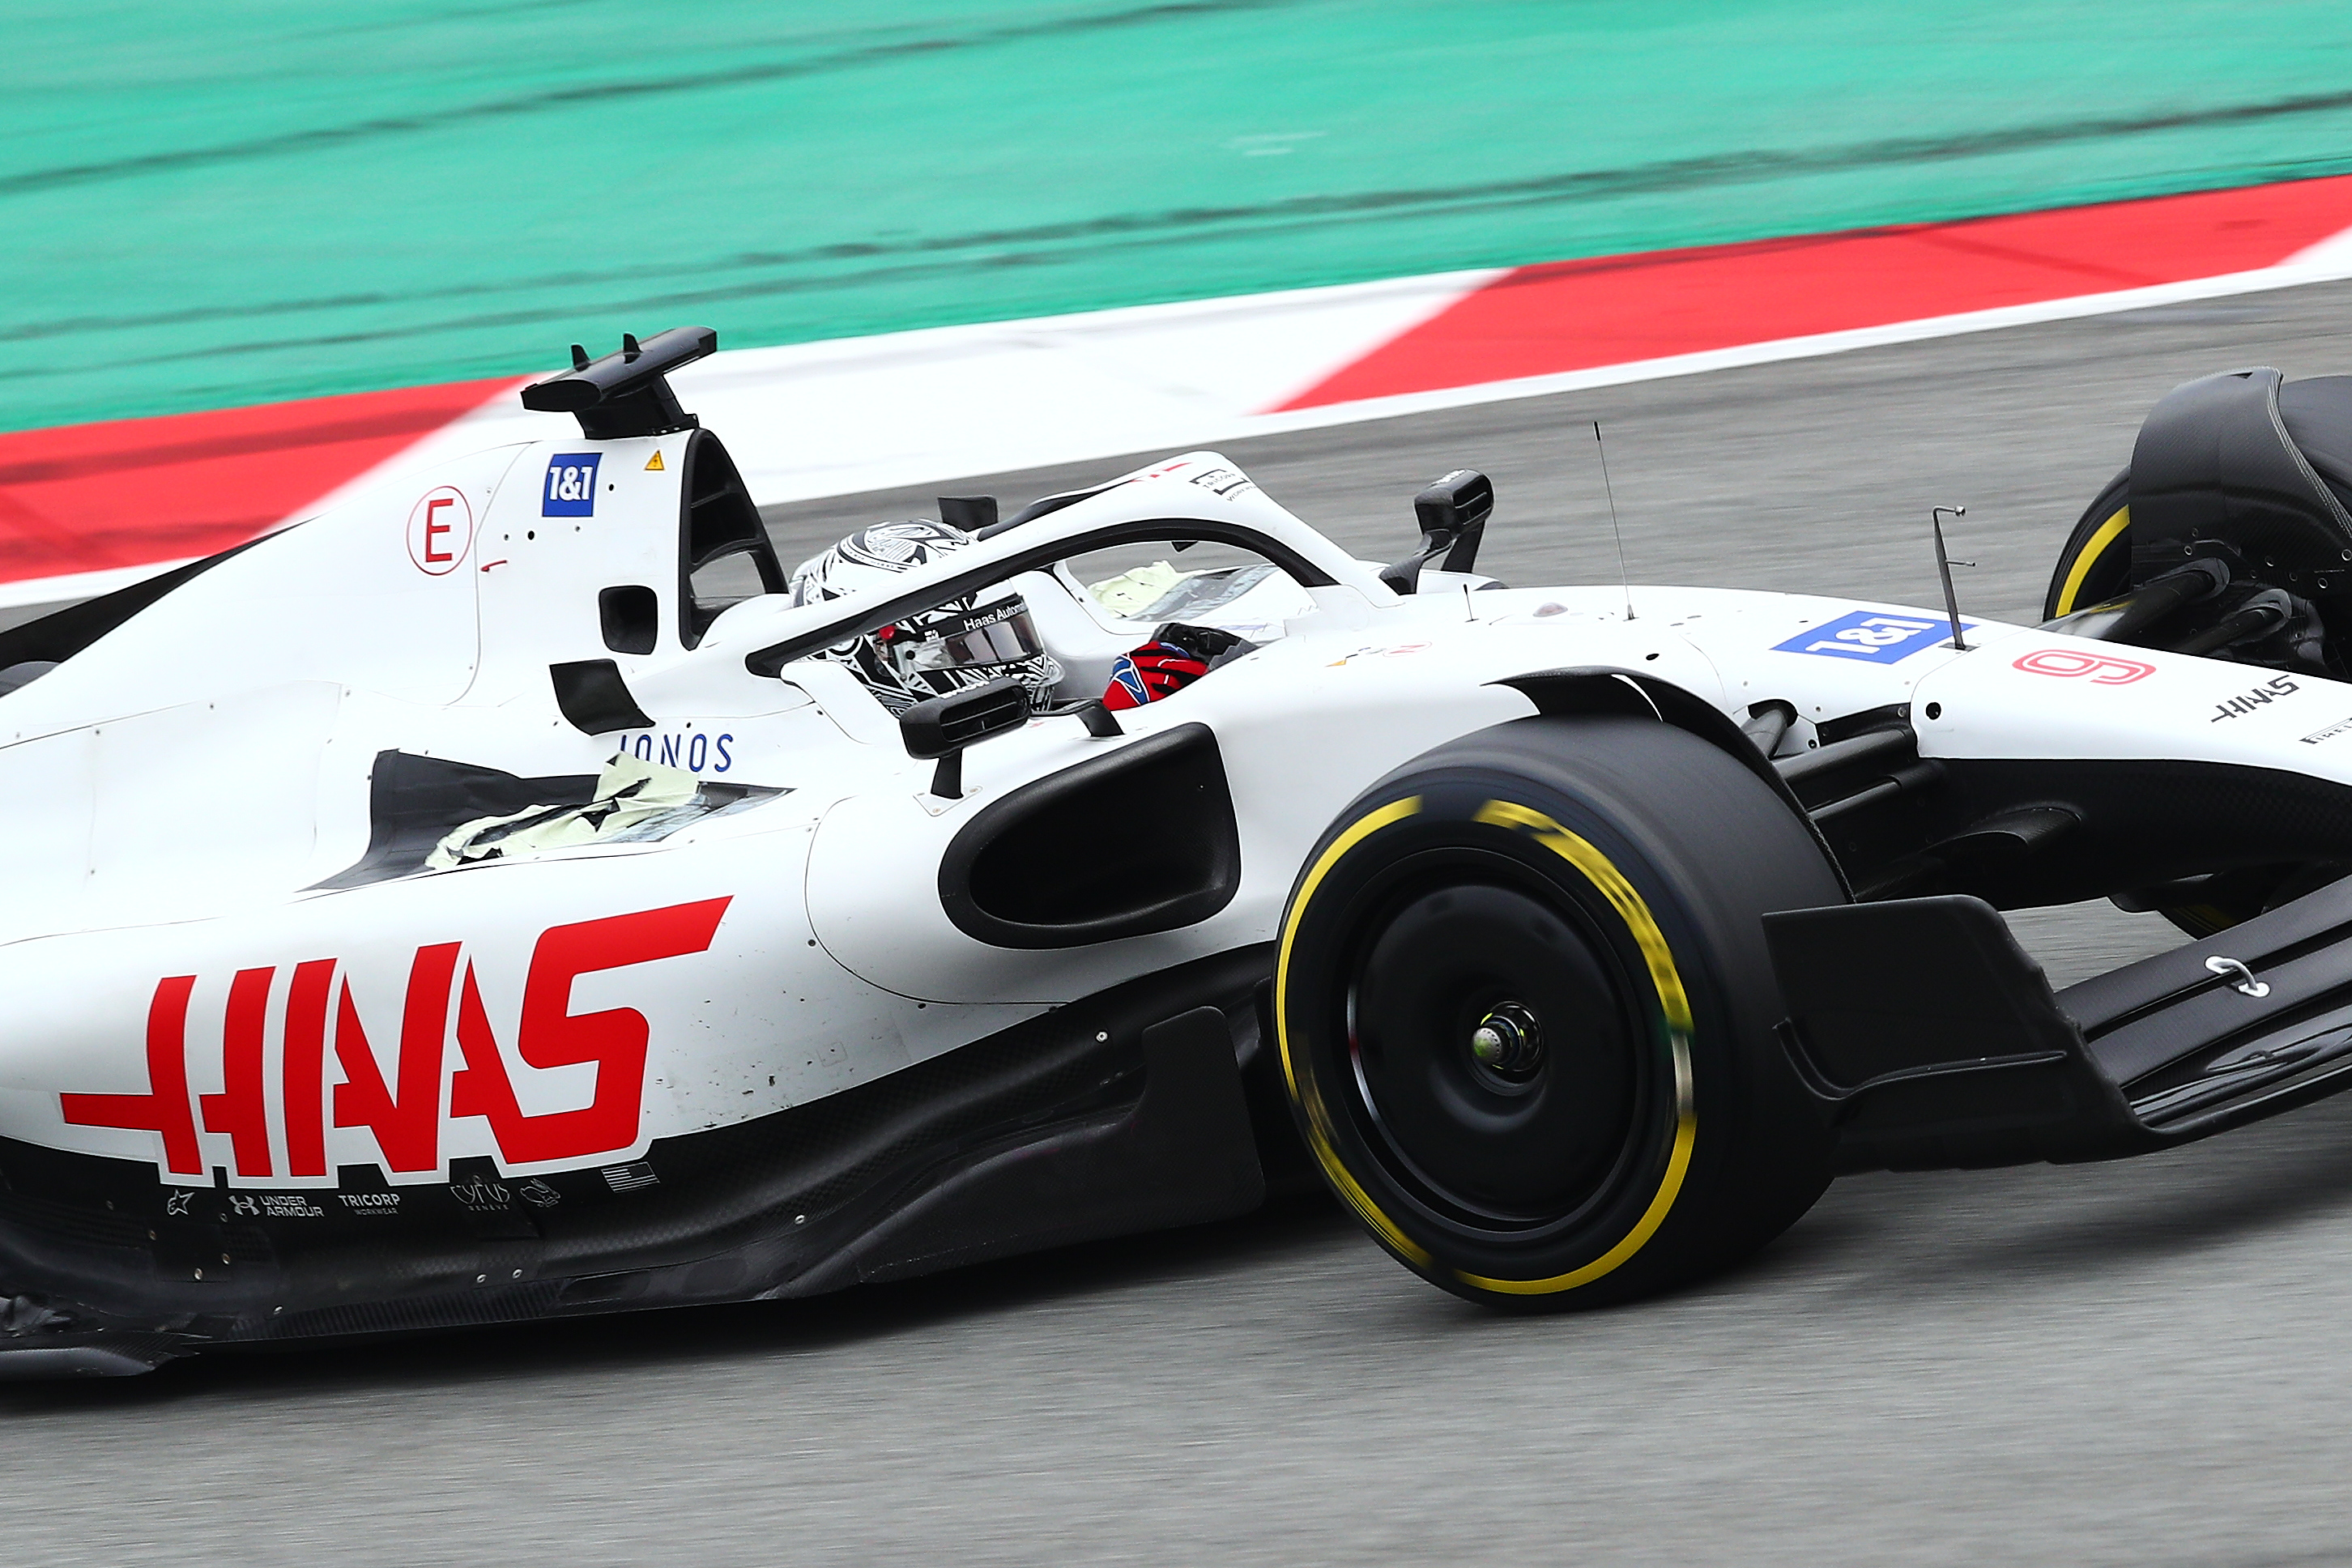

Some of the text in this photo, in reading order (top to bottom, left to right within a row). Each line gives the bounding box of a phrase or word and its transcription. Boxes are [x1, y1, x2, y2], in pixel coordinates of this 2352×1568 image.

[548, 464, 594, 502] 1&1
[426, 498, 454, 563] E
[963, 613, 996, 632] Haas
[1804, 616, 1937, 654] 1&1
[2011, 649, 2158, 685] 9
[2210, 674, 2300, 723] HAAS
[60, 895, 734, 1178] HAAS
[259, 1195, 307, 1206] UNDER
[266, 1206, 324, 1216] ARMOUR
[338, 1193, 400, 1208] TRICORP
[353, 1207, 399, 1216] WORKWEAR
